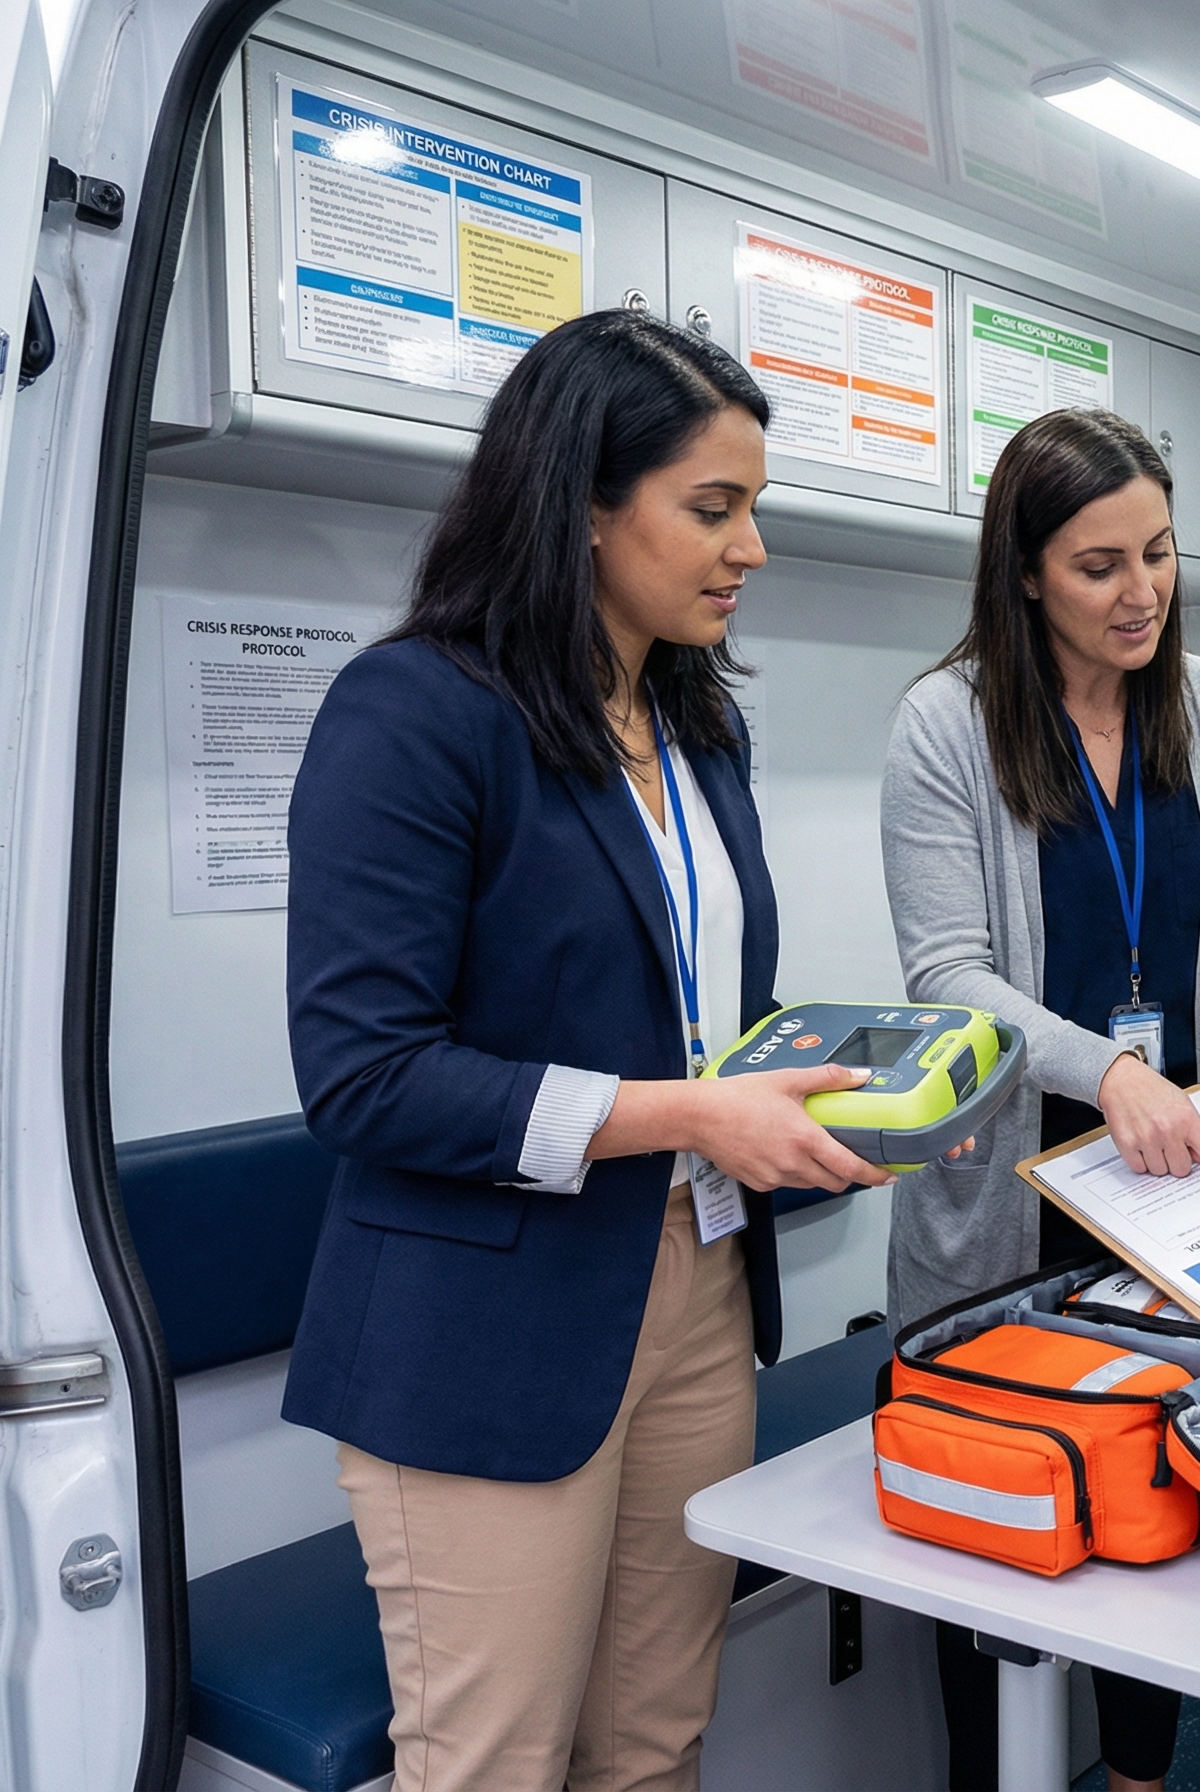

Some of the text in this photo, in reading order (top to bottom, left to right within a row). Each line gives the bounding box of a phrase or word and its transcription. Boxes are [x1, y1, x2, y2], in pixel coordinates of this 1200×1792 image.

[388, 126, 500, 175] INTERVENTION
[503, 164, 552, 190] CHART
[186, 620, 357, 643] CRISIS RESPONSE PROTOCOL
[241, 642, 307, 658] PROTOCOL
[747, 1035, 784, 1064] AED
